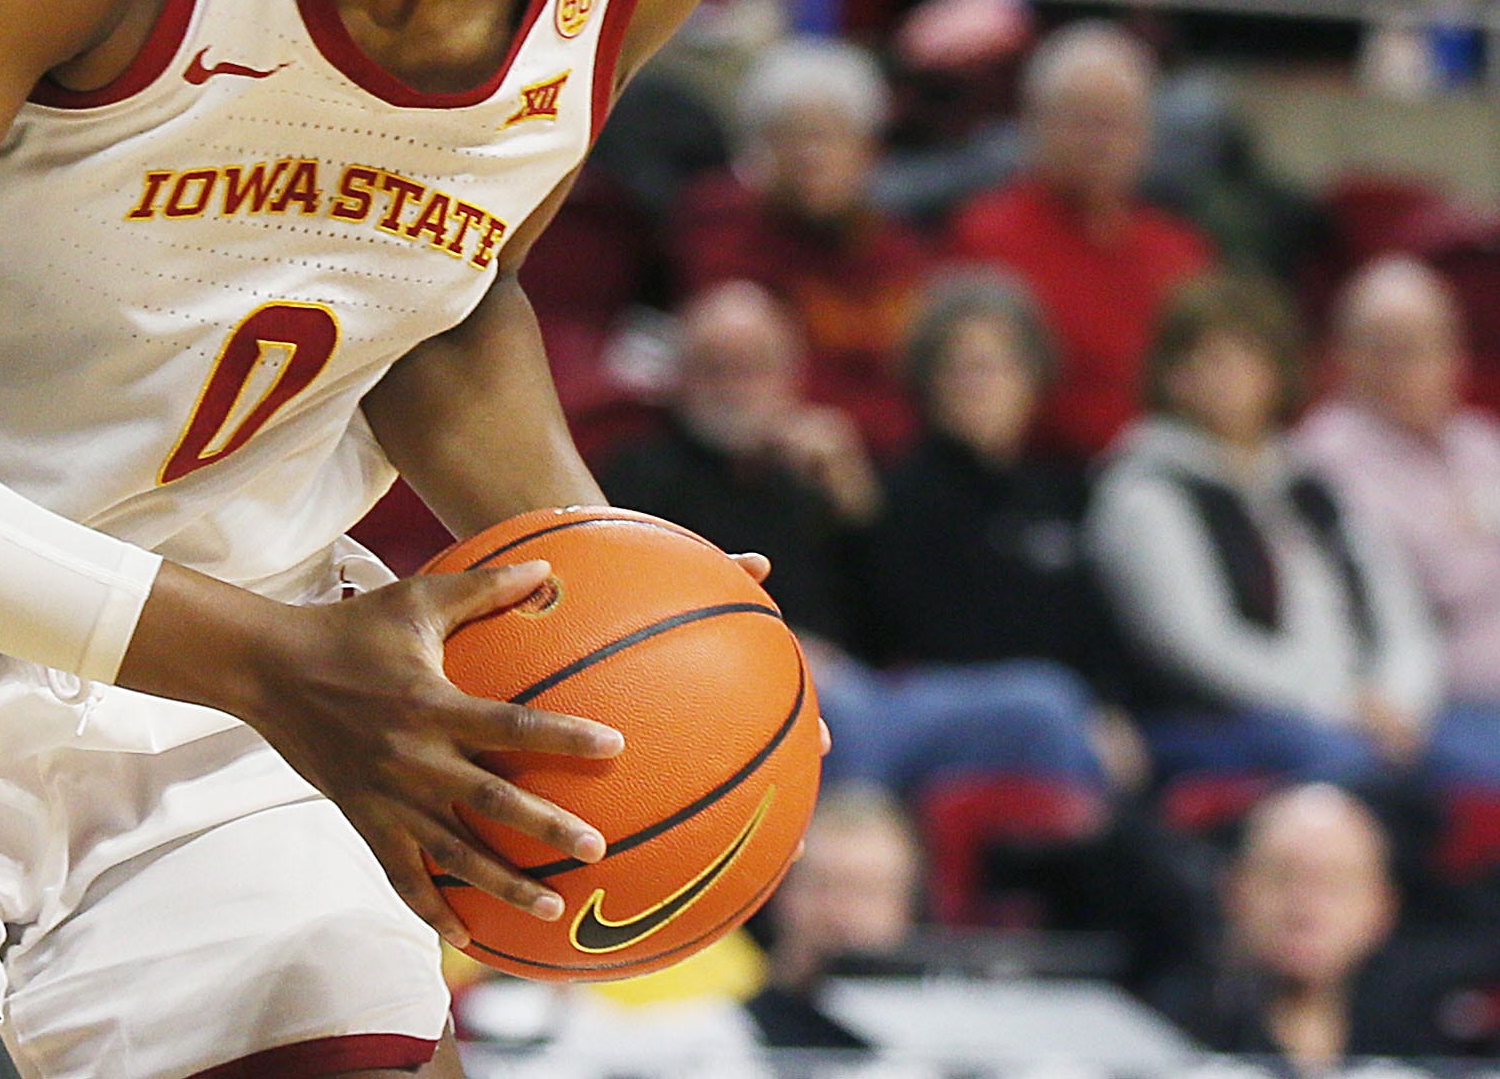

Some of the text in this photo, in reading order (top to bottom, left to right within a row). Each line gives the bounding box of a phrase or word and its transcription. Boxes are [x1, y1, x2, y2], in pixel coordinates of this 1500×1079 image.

[124, 157, 507, 271] IOWA STATE
[156, 300, 342, 488] 0
